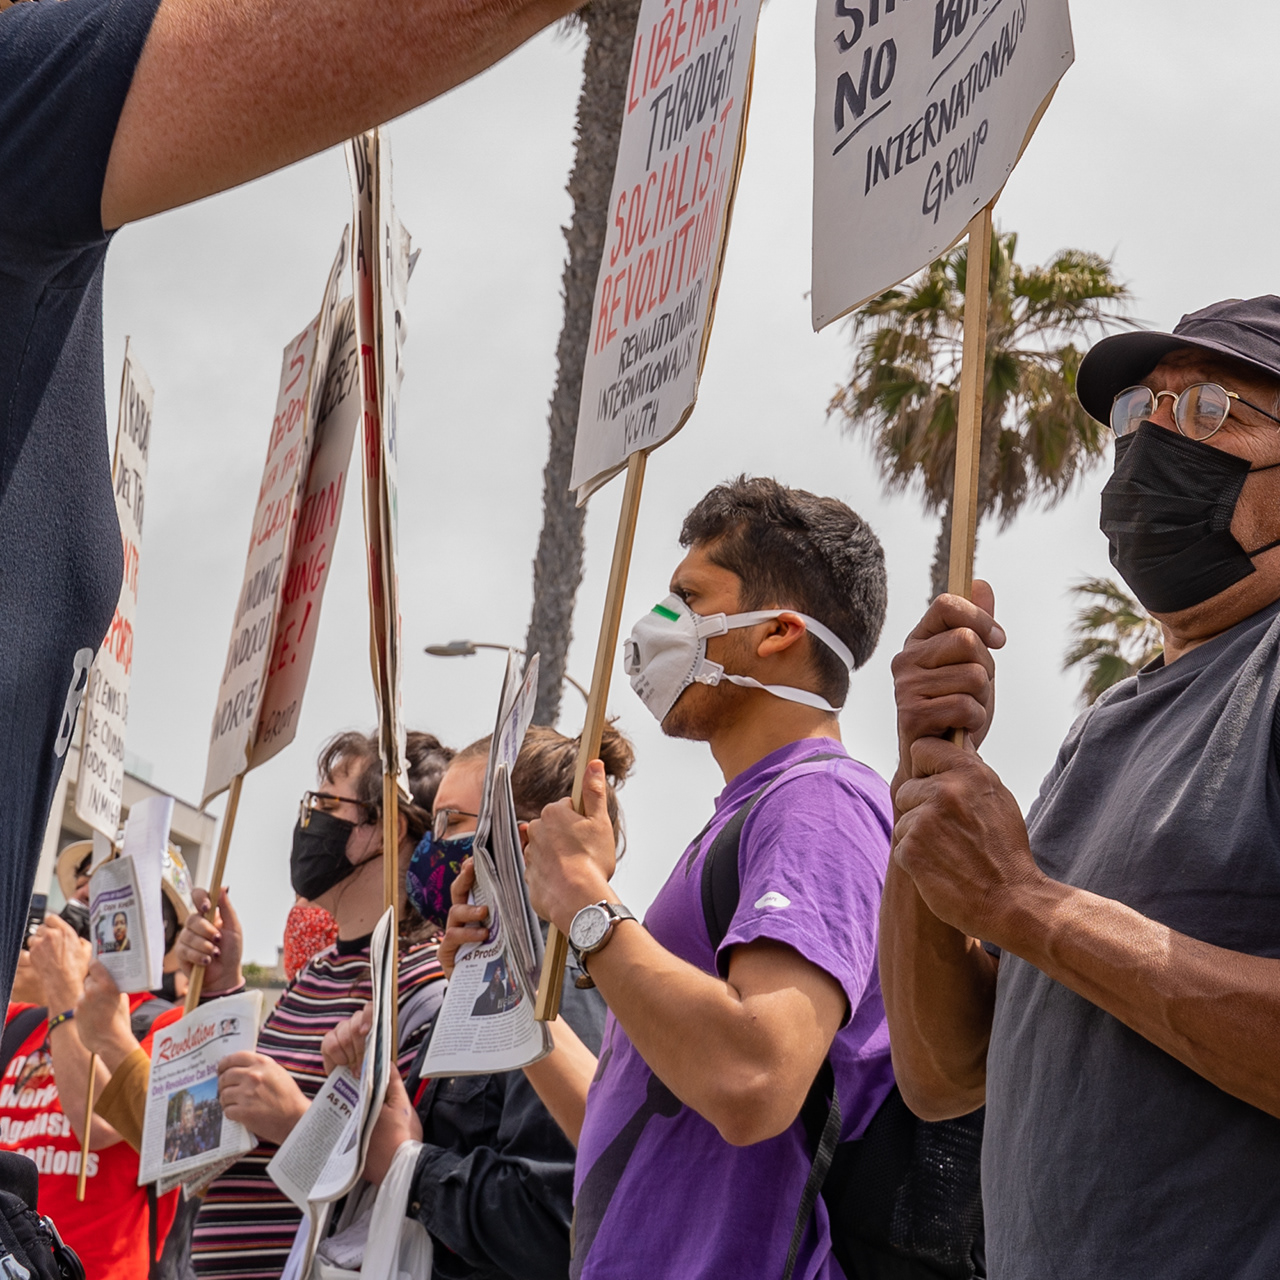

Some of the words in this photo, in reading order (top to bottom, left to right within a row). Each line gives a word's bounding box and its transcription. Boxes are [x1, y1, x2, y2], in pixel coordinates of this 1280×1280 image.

[646, 14, 742, 172] THROUGH
[833, 37, 897, 135] NO
[609, 95, 734, 269] SOCIALIST
[922, 118, 989, 225] GROUP
[596, 328, 699, 423] INTERNATIONALIST
[617, 275, 705, 379] REVOLUTIONARY
[622, 397, 660, 456] YOUTH
[294, 472, 342, 551] TION
[156, 1023, 216, 1064] Revolution
